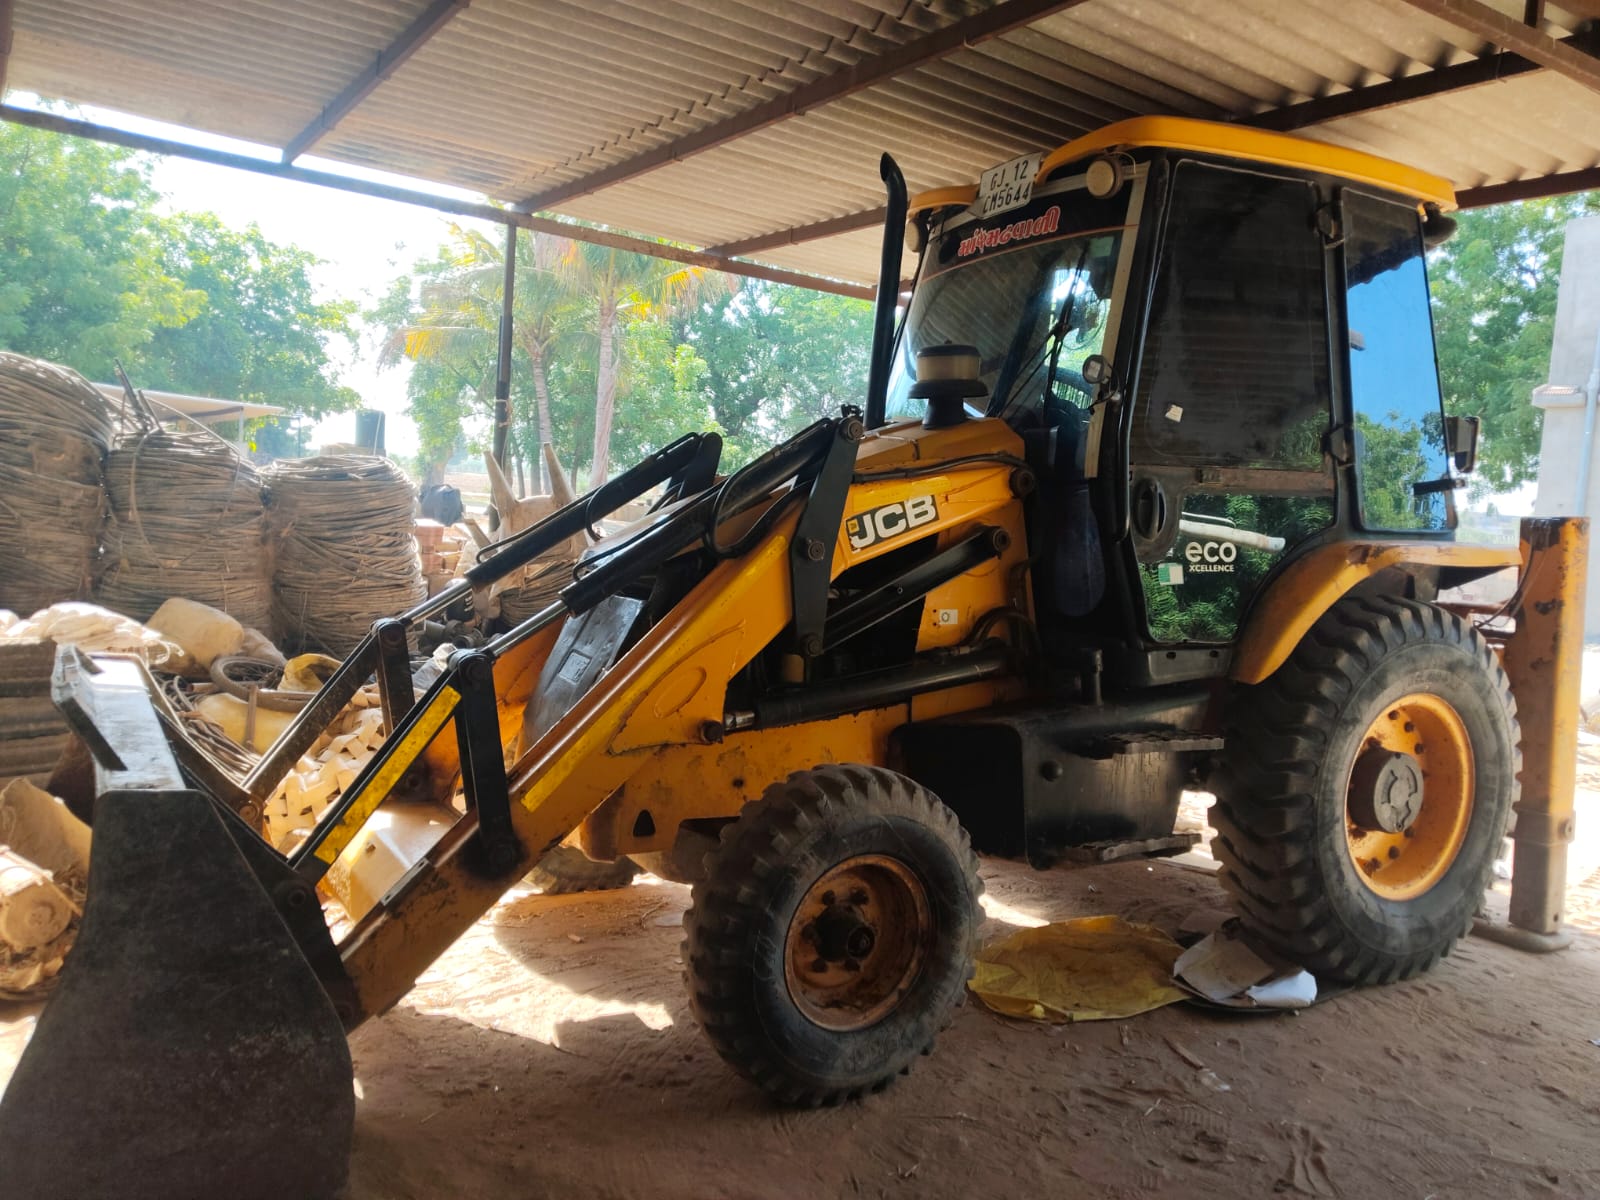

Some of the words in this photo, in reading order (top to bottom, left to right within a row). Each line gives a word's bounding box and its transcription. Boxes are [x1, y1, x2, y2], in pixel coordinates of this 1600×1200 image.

[1014, 160, 1029, 181] 12
[982, 182, 1031, 213] CM5644
[850, 494, 937, 549] JCB
[1185, 541, 1237, 563] eco
[1189, 564, 1235, 572] XCELLENCE
